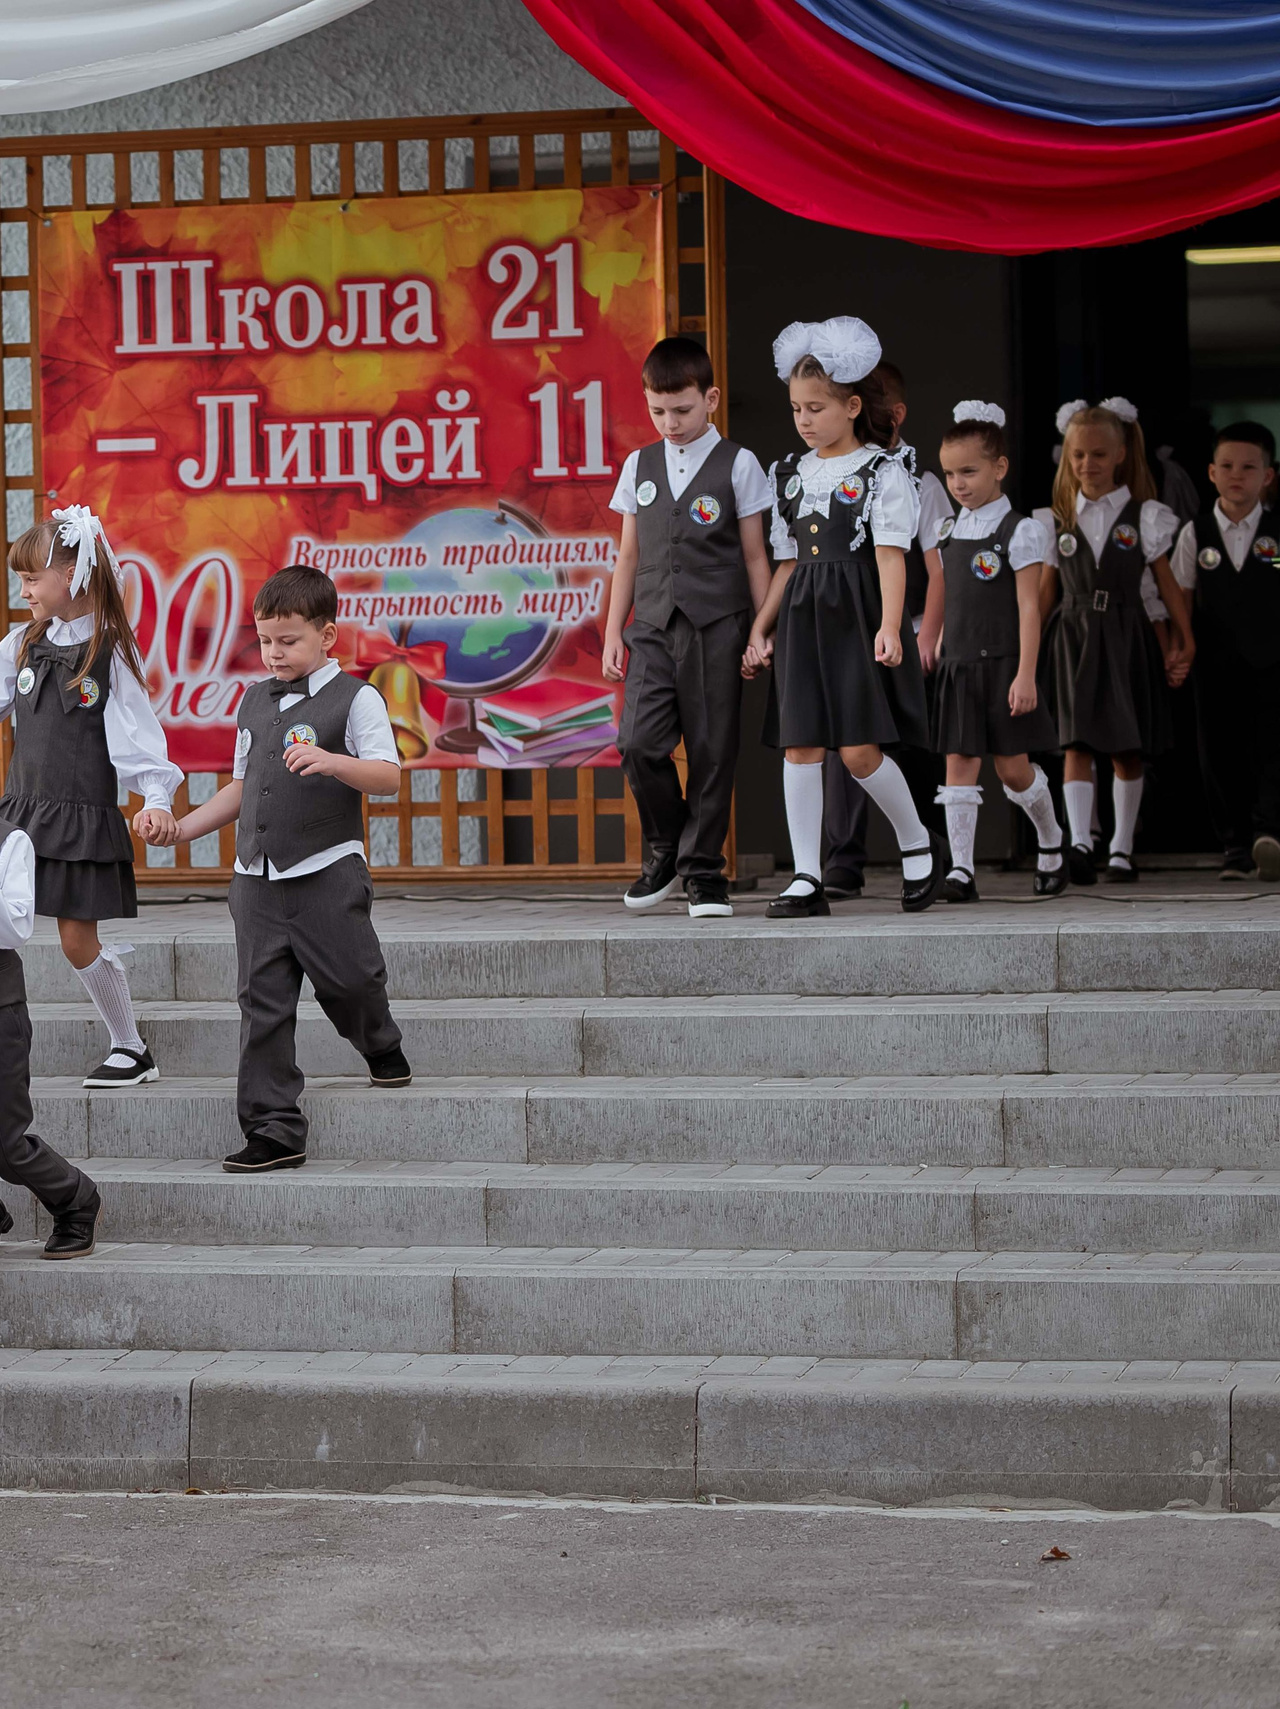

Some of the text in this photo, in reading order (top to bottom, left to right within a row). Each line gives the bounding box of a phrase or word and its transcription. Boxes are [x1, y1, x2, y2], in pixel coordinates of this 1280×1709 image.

[112, 243, 583, 354] Школа 21
[178, 389, 481, 502] Лицей
[529, 381, 613, 478] 11
[293, 535, 618, 574] Верность традициям,
[336, 583, 600, 625] ткрытость миру!
